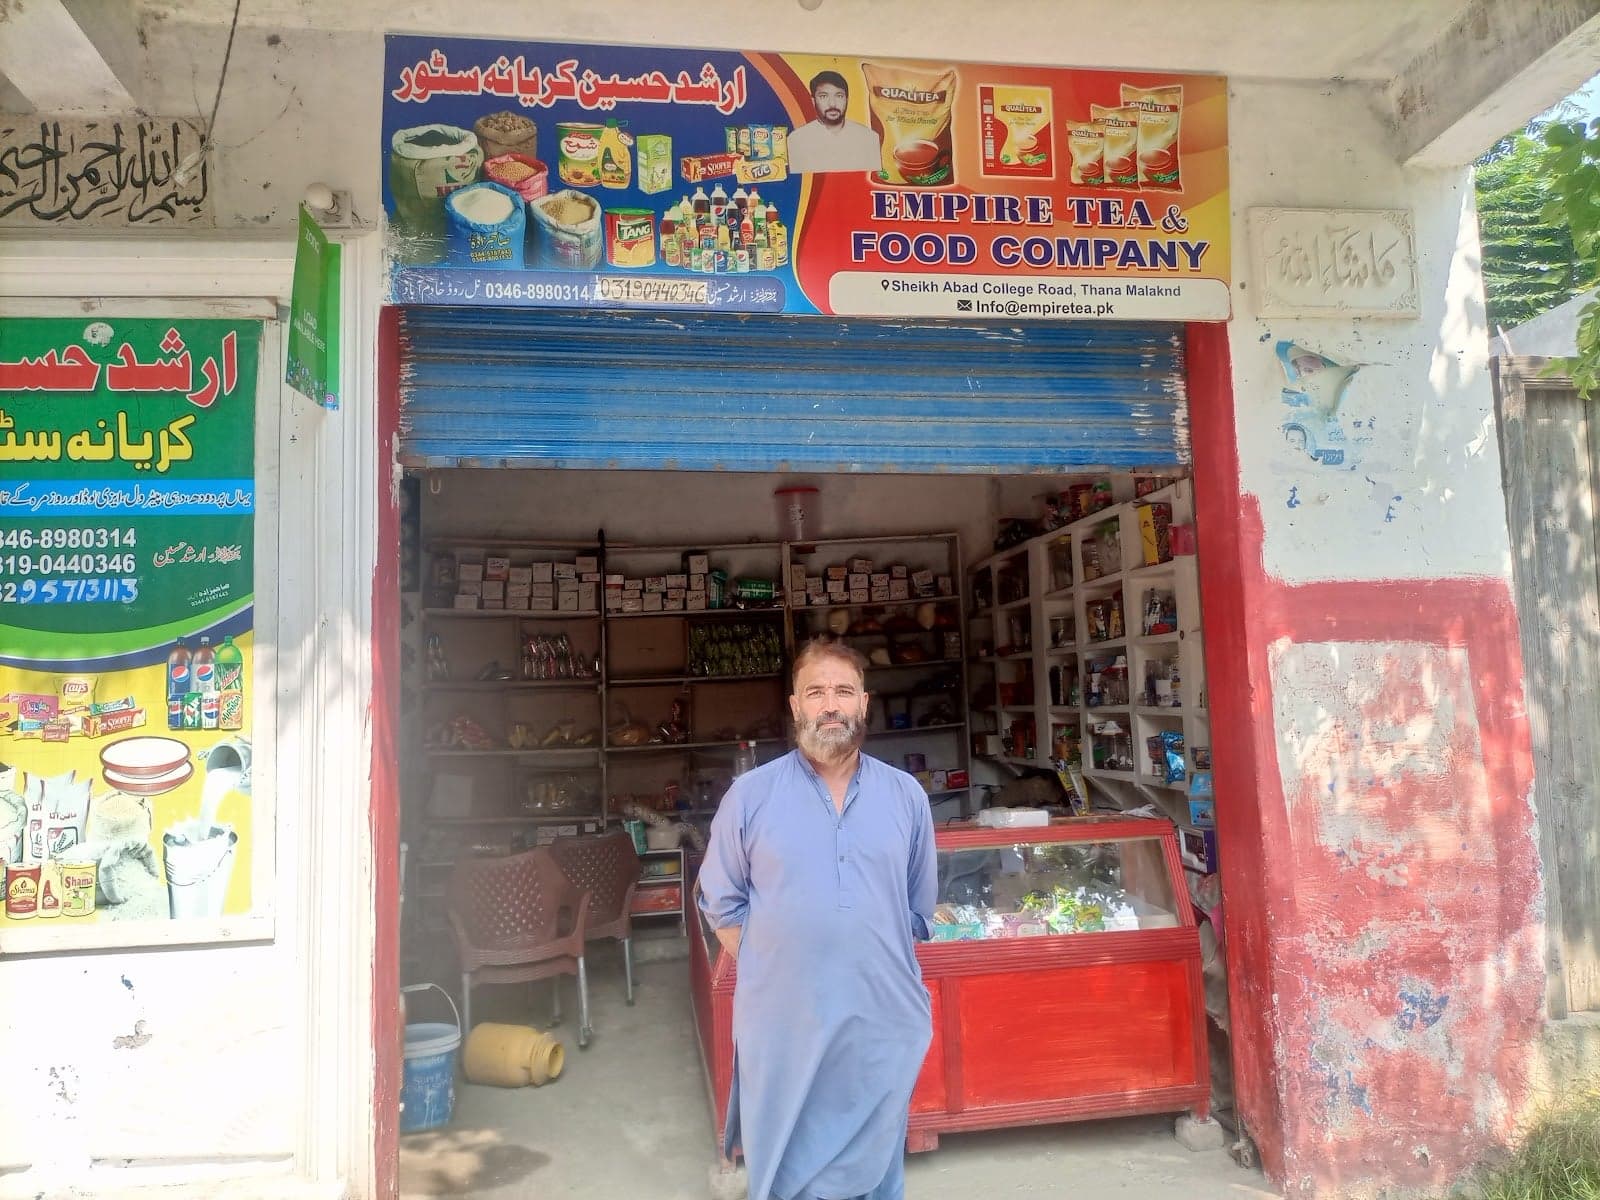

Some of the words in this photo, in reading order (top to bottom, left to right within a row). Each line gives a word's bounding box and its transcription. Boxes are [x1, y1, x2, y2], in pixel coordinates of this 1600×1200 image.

[391, 49, 482, 104] سٹور
[483, 55, 579, 109] کریانہ
[673, 62, 747, 115] ارشد
[577, 69, 673, 111] حسین
[751, 165, 771, 179] TUC
[871, 190, 1054, 226] EMPIRE
[1066, 197, 1155, 229] TEA
[1160, 206, 1189, 233] &
[620, 224, 651, 240] TANG
[851, 231, 977, 266] FOOD
[991, 236, 1209, 273] COMPANY
[485, 282, 589, 302] 0346-8980314
[706, 281, 730, 306] حسین
[727, 285, 747, 304] ارشد
[892, 279, 939, 293] Sheikh
[942, 280, 978, 294] Abad
[982, 280, 1034, 297] College
[1038, 282, 1077, 298] Road,
[1081, 282, 1122, 297] Thana
[1126, 283, 1181, 298] Malaknd
[975, 298, 1115, 316] Info@empiretea.pk
[0, 344, 101, 392] حس
[106, 327, 238, 407] ارشد
[0, 408, 62, 461] سٹ
[66, 411, 197, 473] کریانہ
[226, 488, 251, 507] یہاں
[0, 553, 136, 575] 19-0440346
[152, 541, 187, 568] حسین
[179, 545, 207, 563] ارشد
[64, 875, 93, 890] Shama
